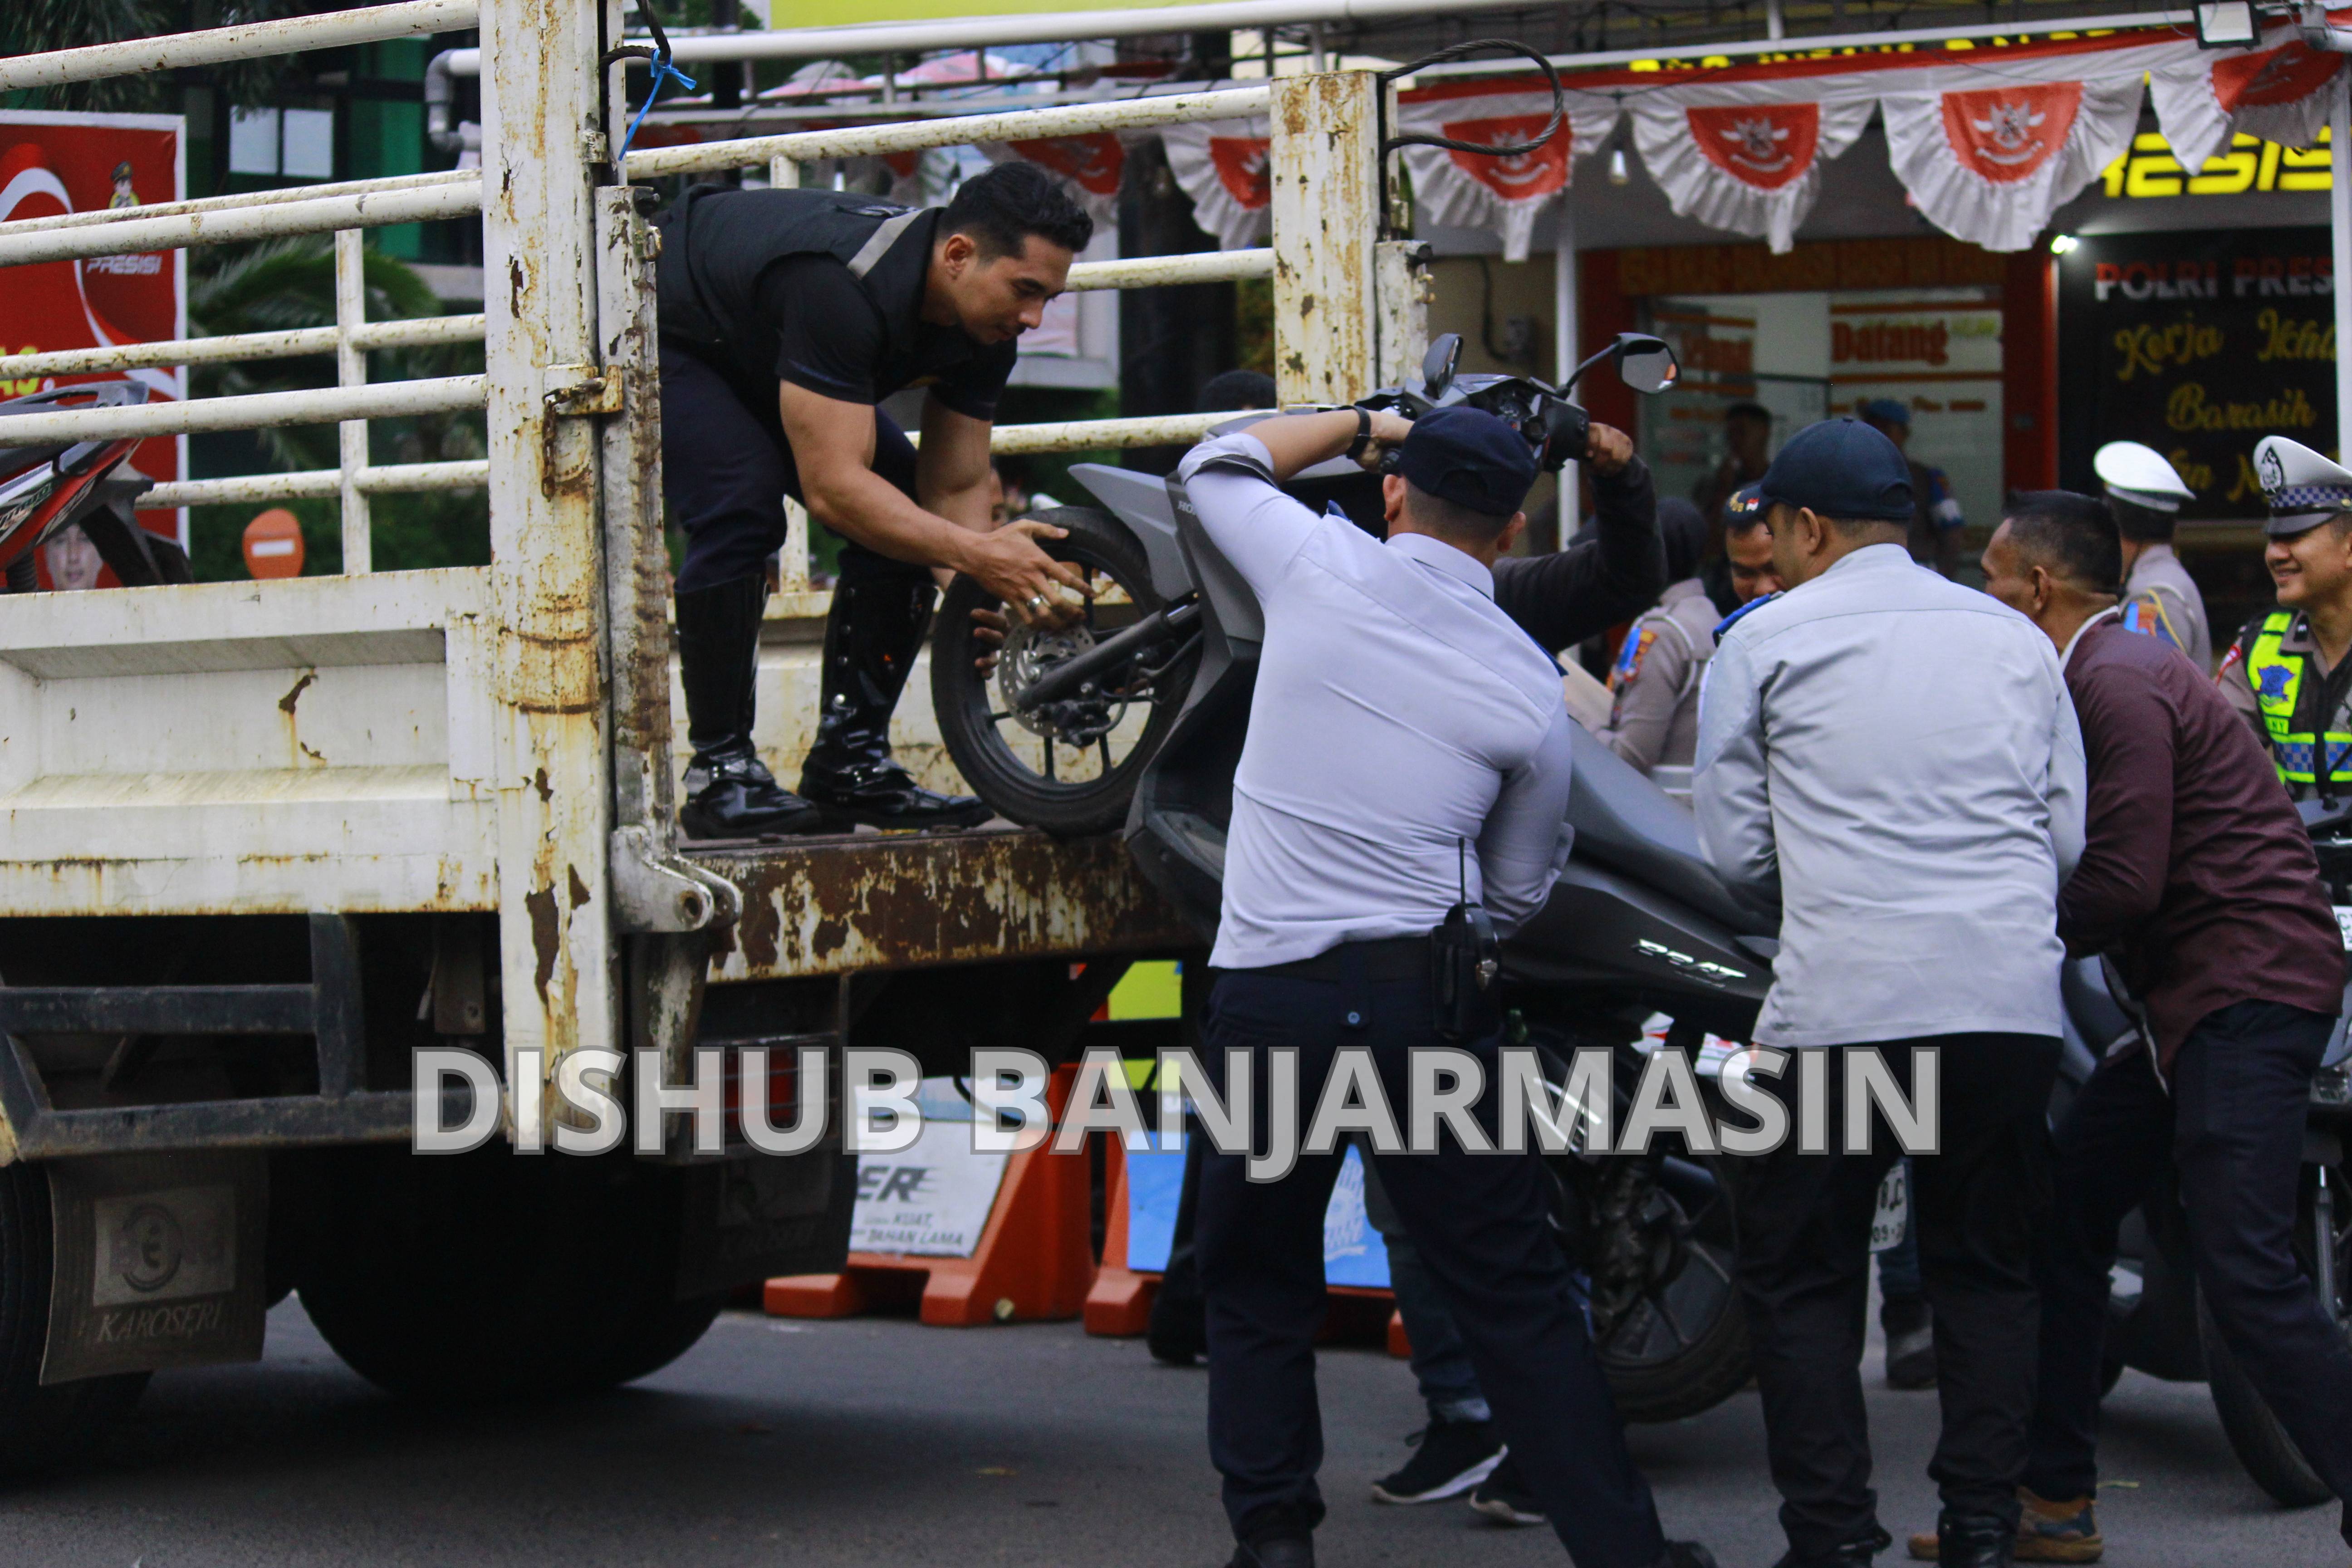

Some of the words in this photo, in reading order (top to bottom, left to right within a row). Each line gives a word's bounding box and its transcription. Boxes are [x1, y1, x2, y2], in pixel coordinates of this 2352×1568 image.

[86, 254, 162, 275] PRESISI
[2093, 262, 2218, 303] POLRI
[1831, 318, 1950, 368] Datang
[2113, 310, 2222, 382] Kerja
[2165, 382, 2318, 432] Barasih
[96, 1299, 223, 1345] KAROSERI
